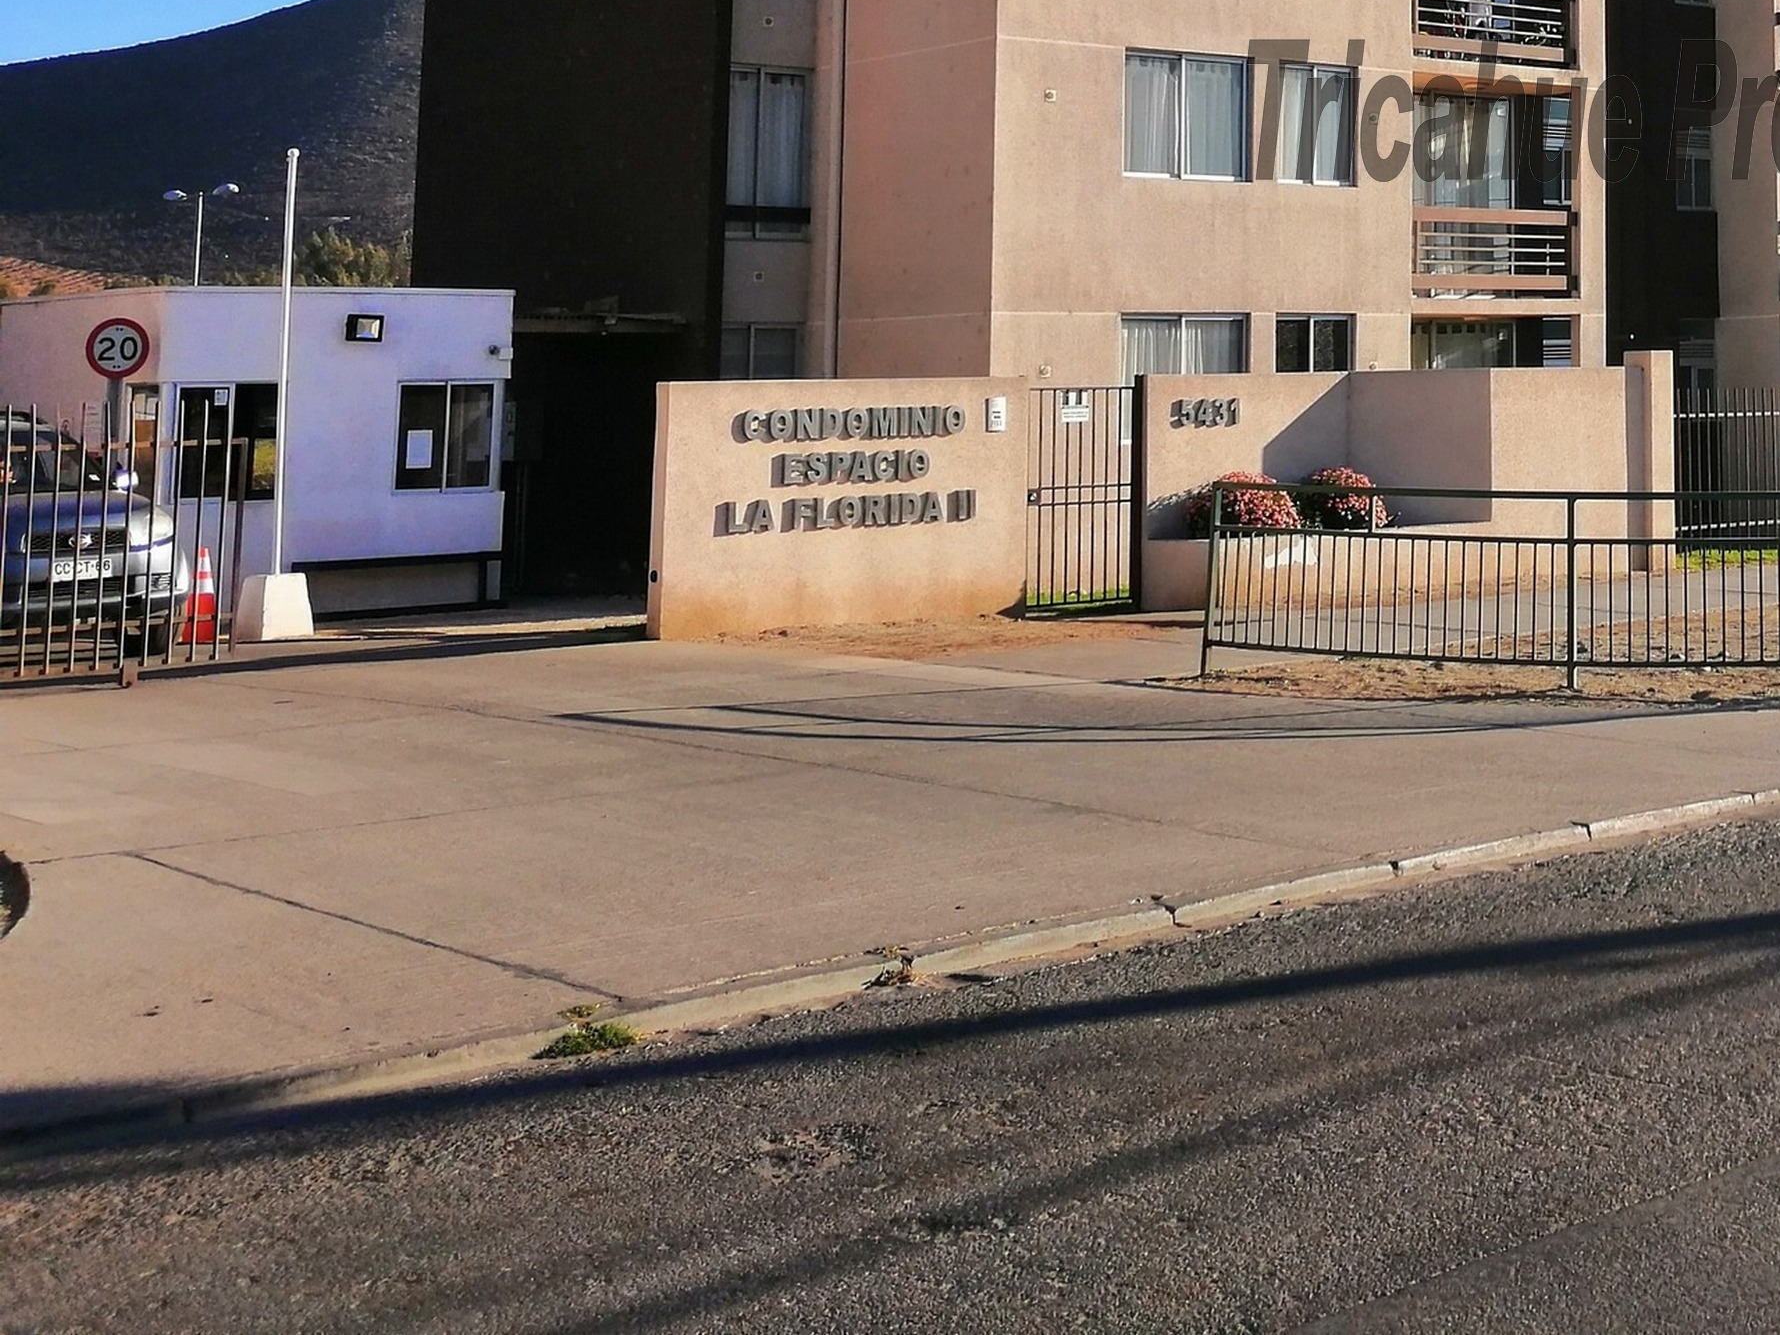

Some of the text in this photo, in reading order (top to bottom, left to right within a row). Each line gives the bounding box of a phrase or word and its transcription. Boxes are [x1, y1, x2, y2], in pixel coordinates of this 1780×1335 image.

[97, 336, 138, 362] 20
[731, 405, 966, 444] CONDOMINIO
[1170, 397, 1240, 429] 5431
[770, 449, 930, 488] ESPACIO
[713, 489, 977, 537] LA FLORIDA II
